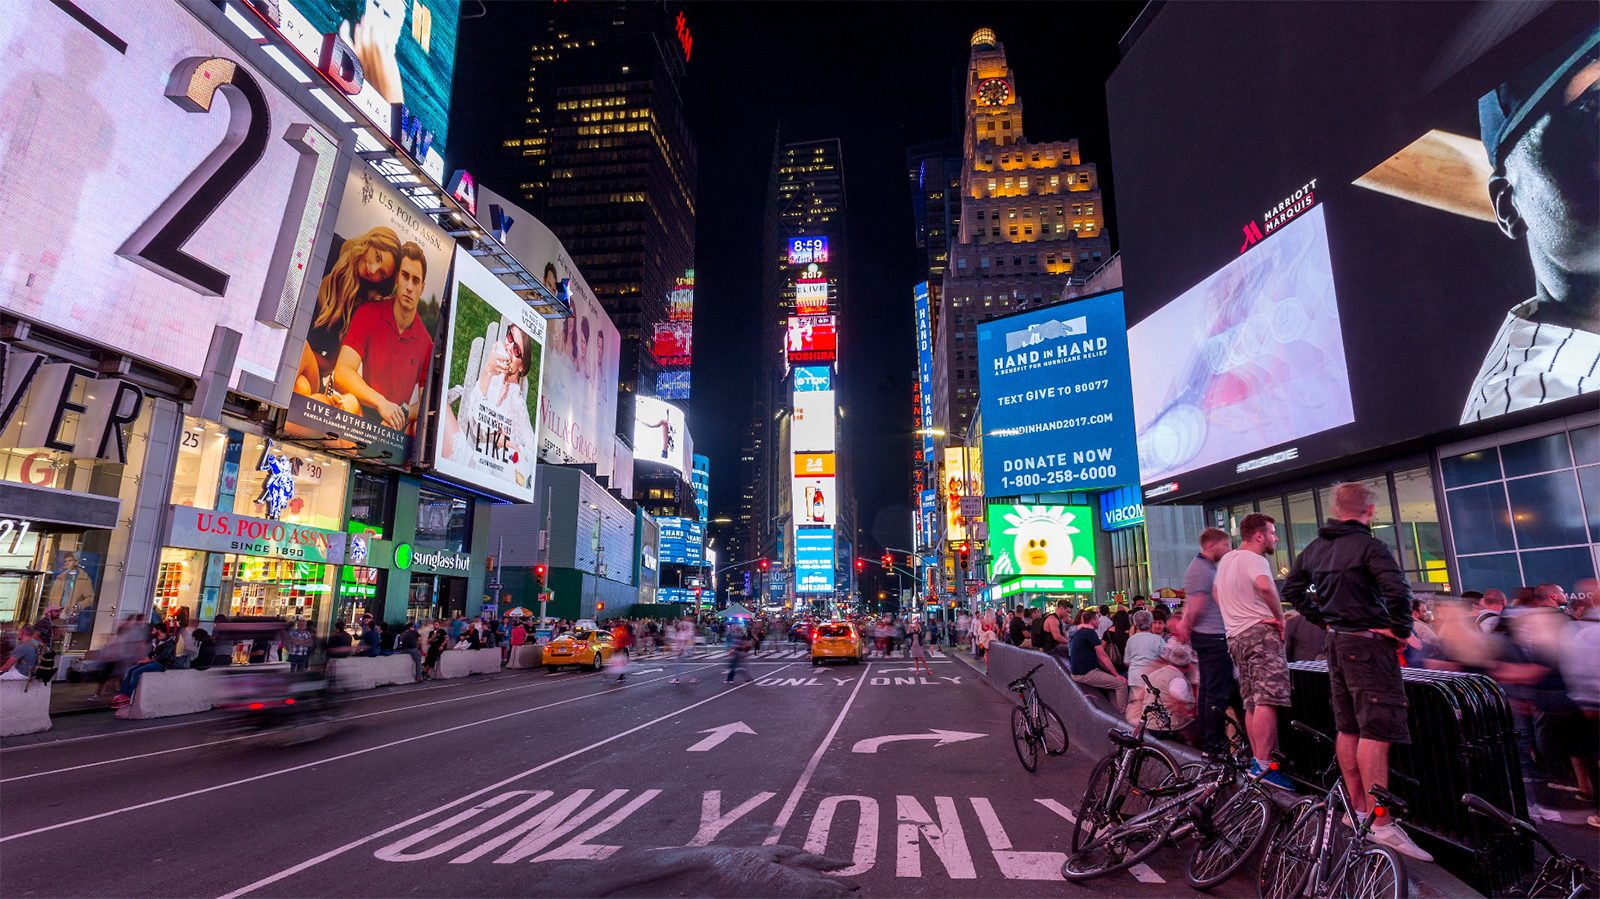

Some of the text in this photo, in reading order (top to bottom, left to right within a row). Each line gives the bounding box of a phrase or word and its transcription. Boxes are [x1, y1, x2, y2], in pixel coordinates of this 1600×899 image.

[1264, 178, 1317, 222] MARRIOTT
[396, 206, 420, 232] POLO
[1266, 195, 1312, 232] MARQUIS
[793, 241, 823, 254] 8:59
[801, 271, 823, 279] 2017
[919, 309, 928, 351] HAND
[789, 352, 835, 362] TOSHIBA
[993, 337, 1108, 370] HAND IN HAND
[1000, 365, 1028, 375] BENEFIT
[1029, 362, 1042, 370] FOR
[1043, 355, 1081, 367] HURRICANE
[1083, 349, 1108, 359] RELIEF
[997, 379, 1109, 406] TEXT GIVE TO 80077
[306, 401, 405, 443] LIVE AUTHENTICALLY
[182, 431, 200, 448] 25
[475, 422, 510, 464] LIKE
[306, 463, 322, 479] $30
[1003, 447, 1113, 473] DONATE NOW
[1001, 464, 1117, 489] 1-800-258-6000
[196, 513, 333, 549] U.S. POLO ASSN.
[231, 541, 304, 557] SINCE 1890
[413, 550, 471, 571] sunglass hut
[755, 676, 855, 686] ONLY
[869, 676, 962, 686] ONLY
[373, 788, 777, 864] ONLY
